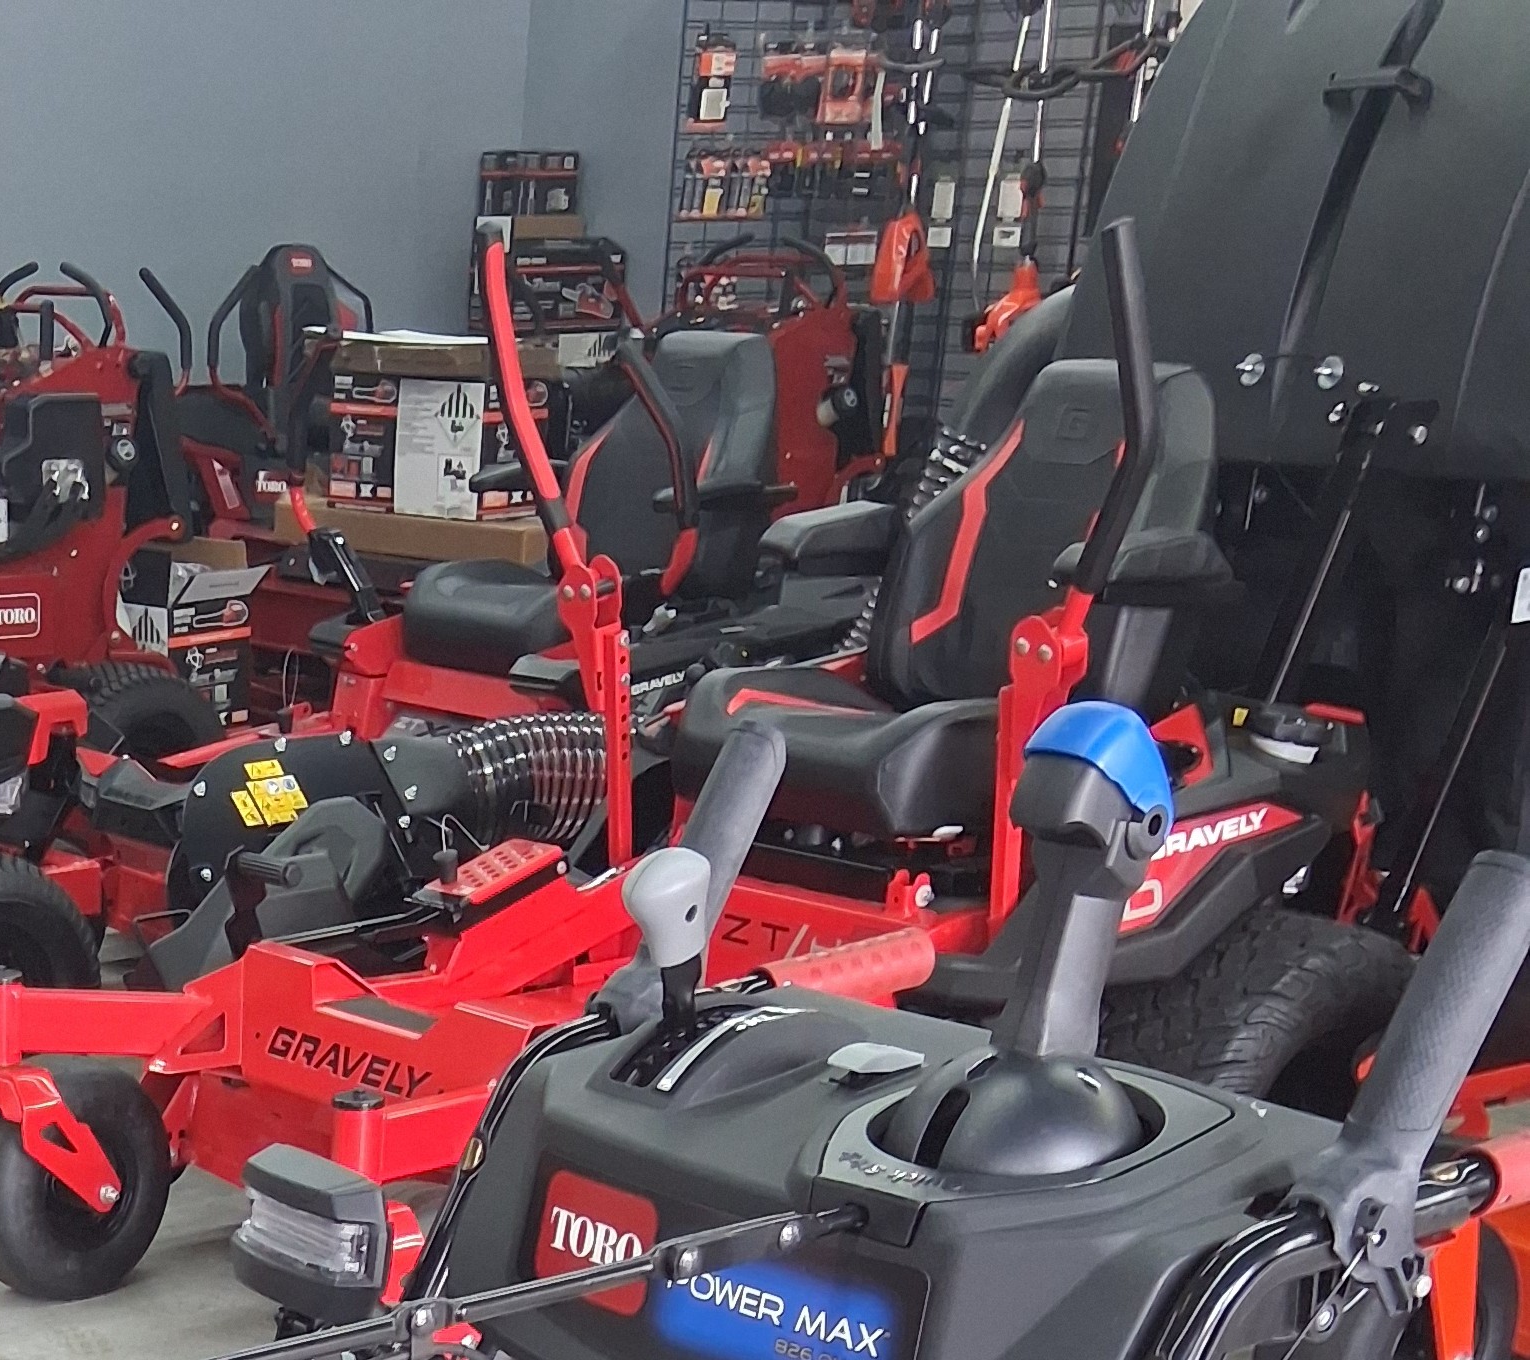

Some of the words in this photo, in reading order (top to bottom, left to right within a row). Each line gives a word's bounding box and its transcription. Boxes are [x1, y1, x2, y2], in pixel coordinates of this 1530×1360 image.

[630, 670, 686, 696] GRAVELY
[268, 1026, 432, 1099] GRAVELY
[551, 1205, 643, 1266] TORO
[795, 1304, 885, 1358] MAX
